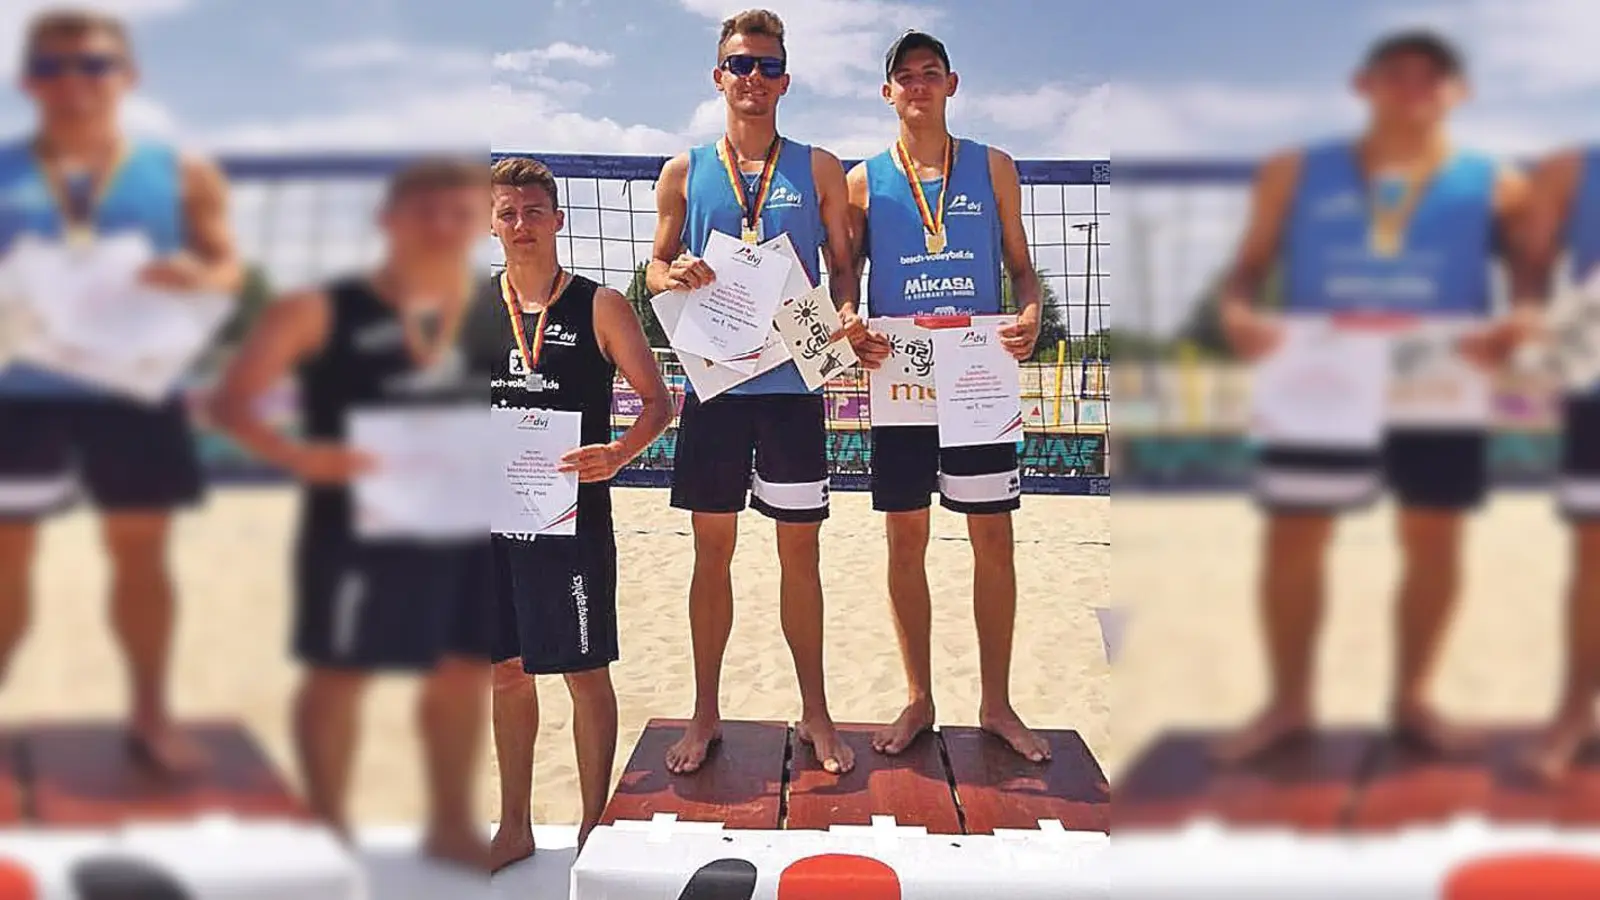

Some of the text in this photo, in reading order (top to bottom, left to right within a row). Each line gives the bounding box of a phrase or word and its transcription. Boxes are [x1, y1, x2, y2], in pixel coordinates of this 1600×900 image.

[747, 253, 763, 267] dvj
[559, 332, 577, 343] dvj
[974, 332, 988, 344] dvj
[533, 417, 550, 428] dvj
